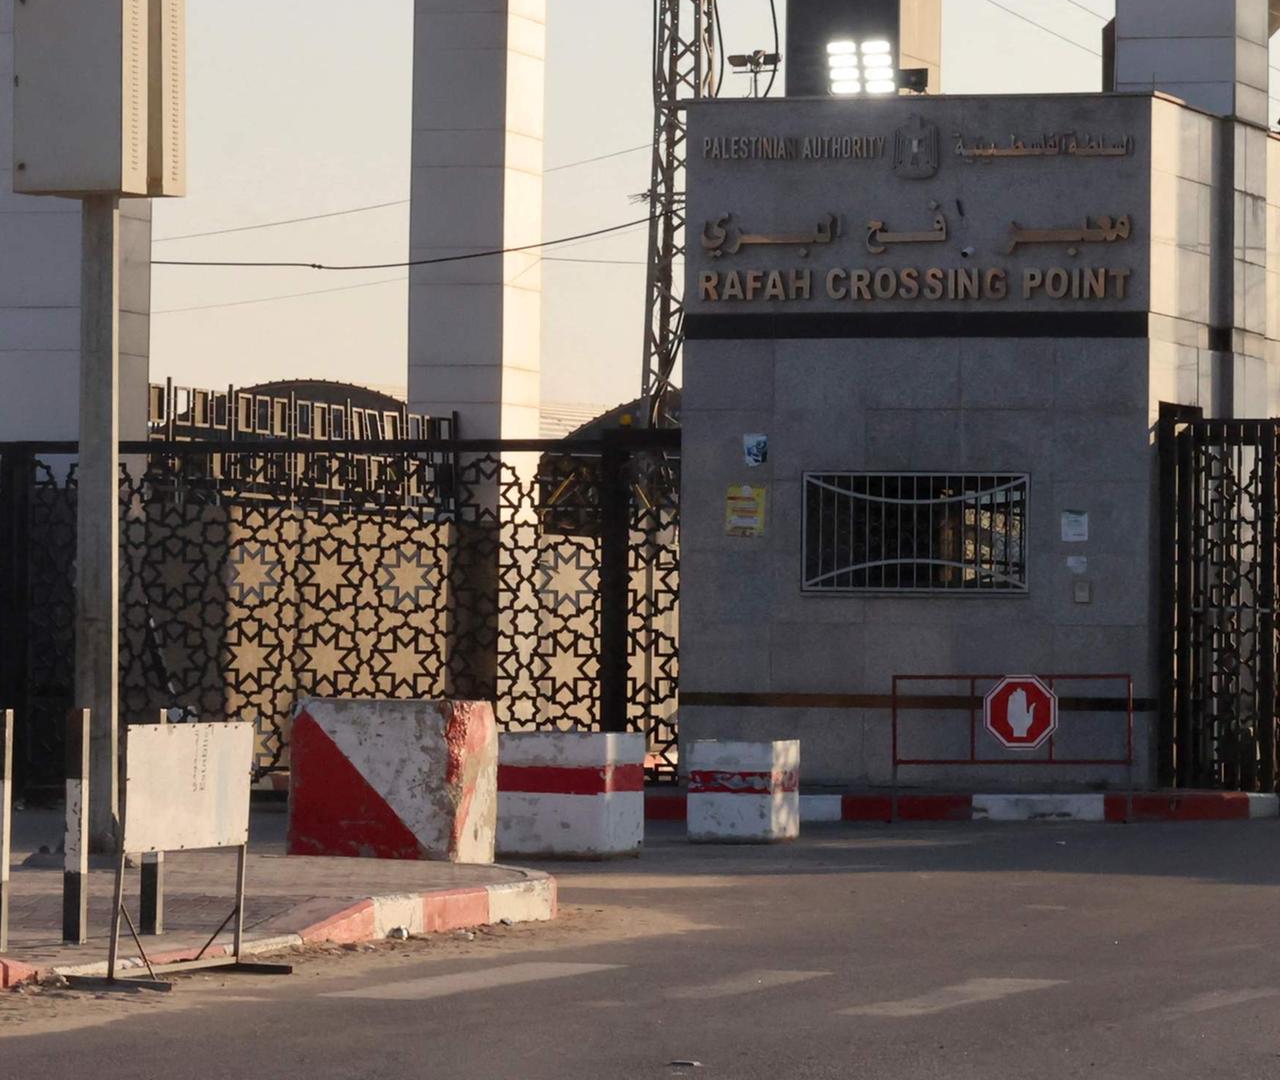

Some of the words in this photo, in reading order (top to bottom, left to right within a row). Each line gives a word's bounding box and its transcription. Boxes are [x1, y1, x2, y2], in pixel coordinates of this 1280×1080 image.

[703, 136, 798, 160] PALESTINIAN
[802, 136, 886, 159] AUTHORITY
[700, 213, 844, 257] البري
[1004, 215, 1132, 256] معبر
[698, 270, 812, 301] RAFAH
[825, 268, 1008, 301] CROSSING
[1023, 269, 1131, 299] POINT
